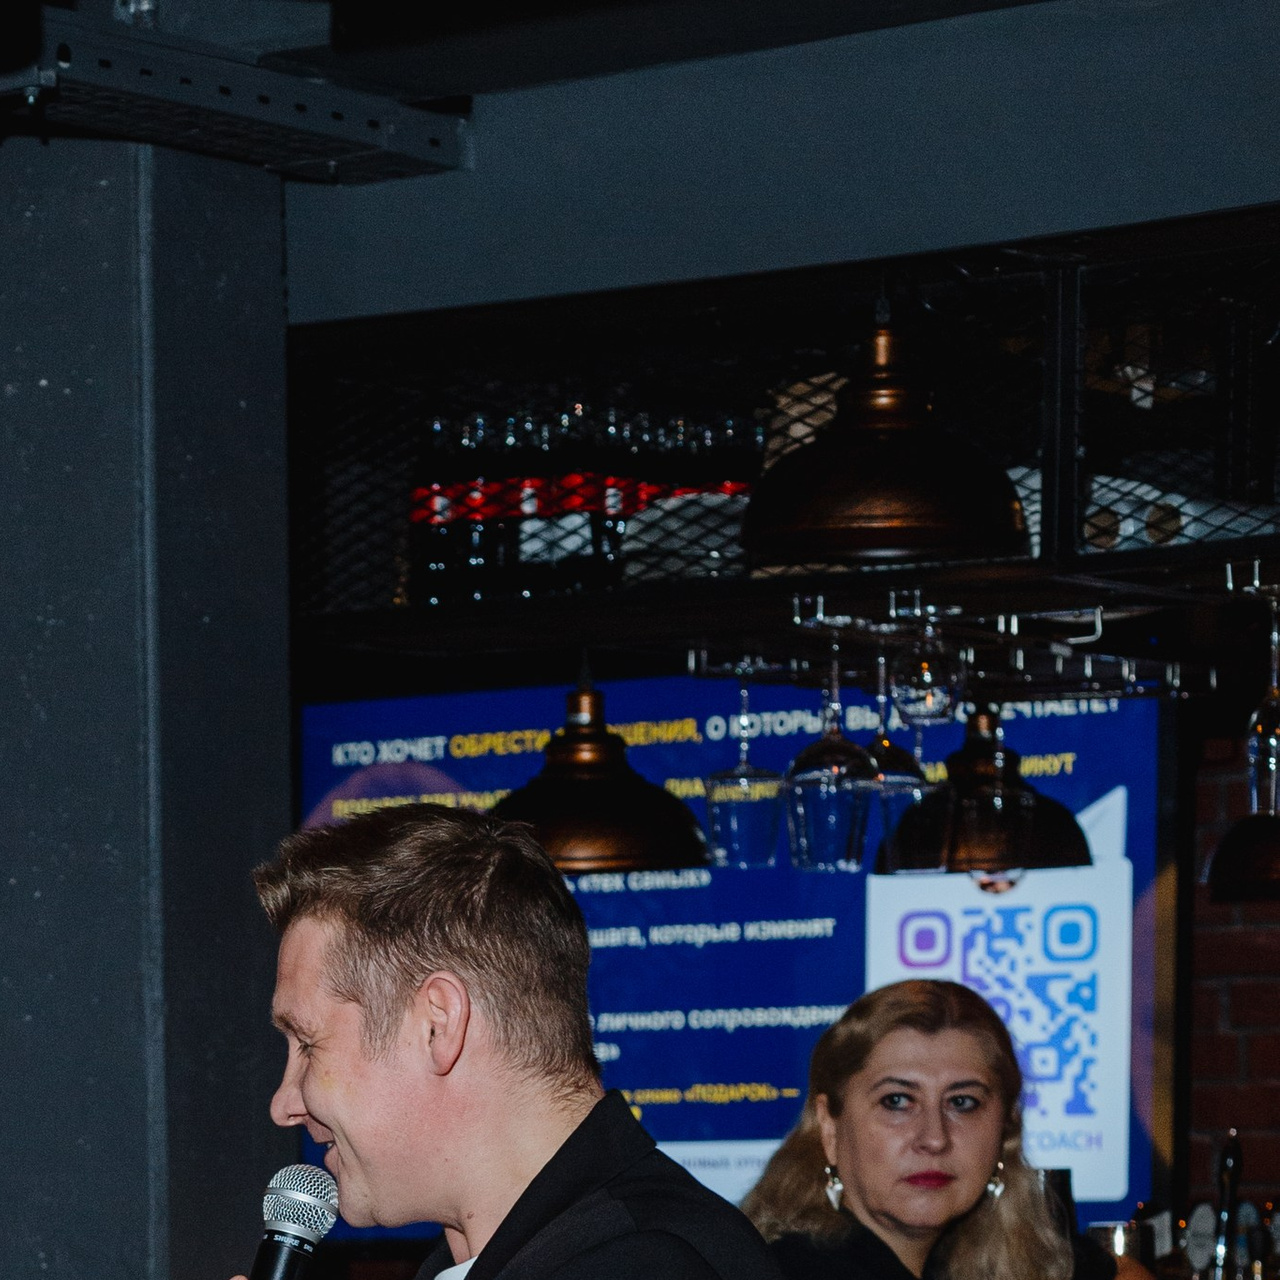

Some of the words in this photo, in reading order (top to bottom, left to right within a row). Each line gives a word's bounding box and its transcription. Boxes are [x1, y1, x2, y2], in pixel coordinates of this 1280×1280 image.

[332, 740, 375, 766] КТО
[376, 735, 447, 763] ХОЧЕТ
[705, 715, 727, 741] О
[648, 922, 741, 947] которые
[743, 917, 837, 941] изменят
[598, 1010, 686, 1031] личного
[688, 1005, 853, 1032] сопровождени
[273, 1234, 300, 1246] SHURE
